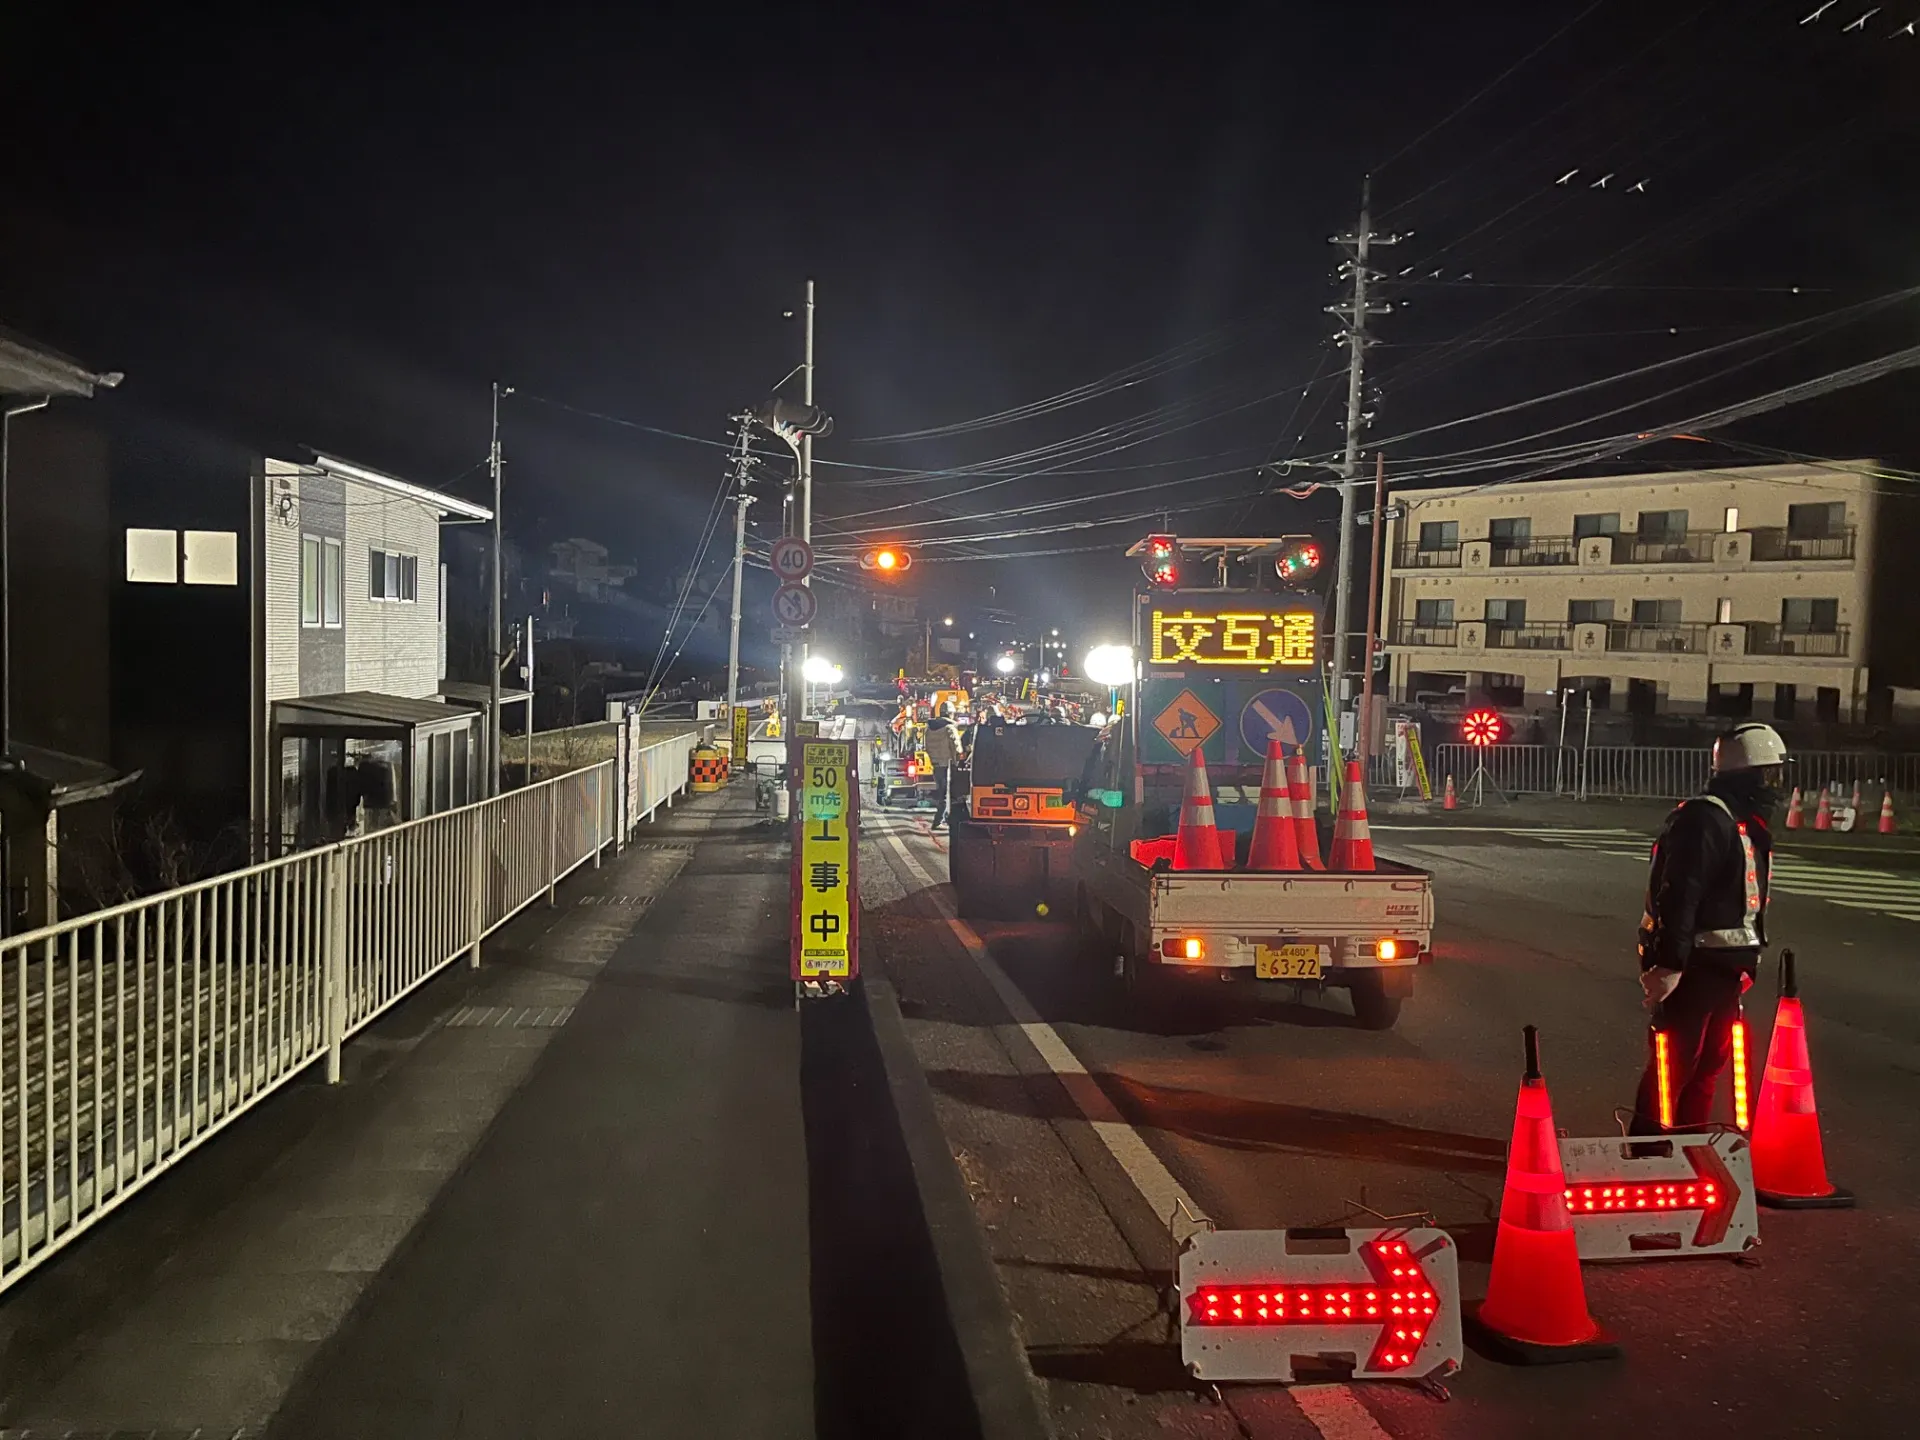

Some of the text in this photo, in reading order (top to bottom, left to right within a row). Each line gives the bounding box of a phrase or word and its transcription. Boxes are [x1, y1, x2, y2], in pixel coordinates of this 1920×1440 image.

[780, 549, 804, 569] 40
[812, 767, 837, 788] 50
[810, 791, 841, 806] m先
[809, 813, 841, 942] 工事中
[1270, 958, 1317, 976] 63-22
